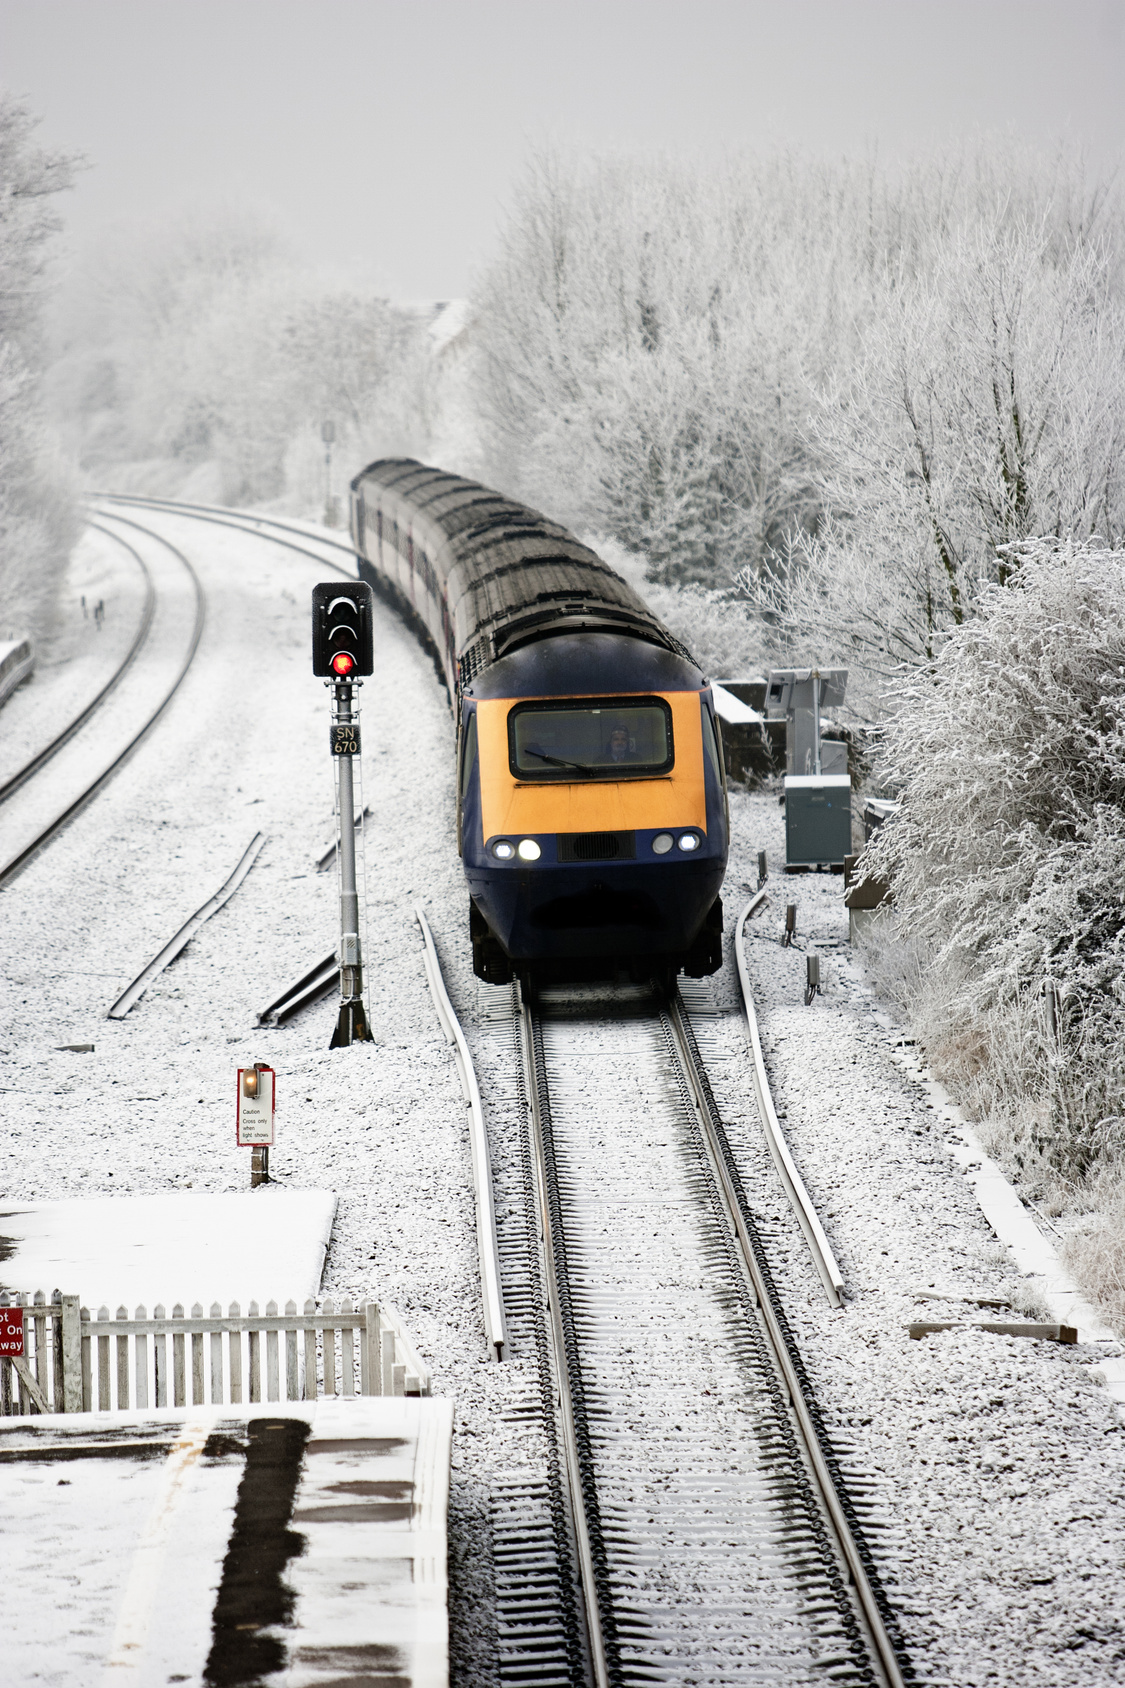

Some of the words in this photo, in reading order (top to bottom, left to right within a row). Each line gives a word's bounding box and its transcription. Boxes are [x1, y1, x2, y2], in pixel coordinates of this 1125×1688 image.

[336, 727, 354, 739] SN
[334, 740, 357, 753] 670
[7, 1325, 22, 1335] On
